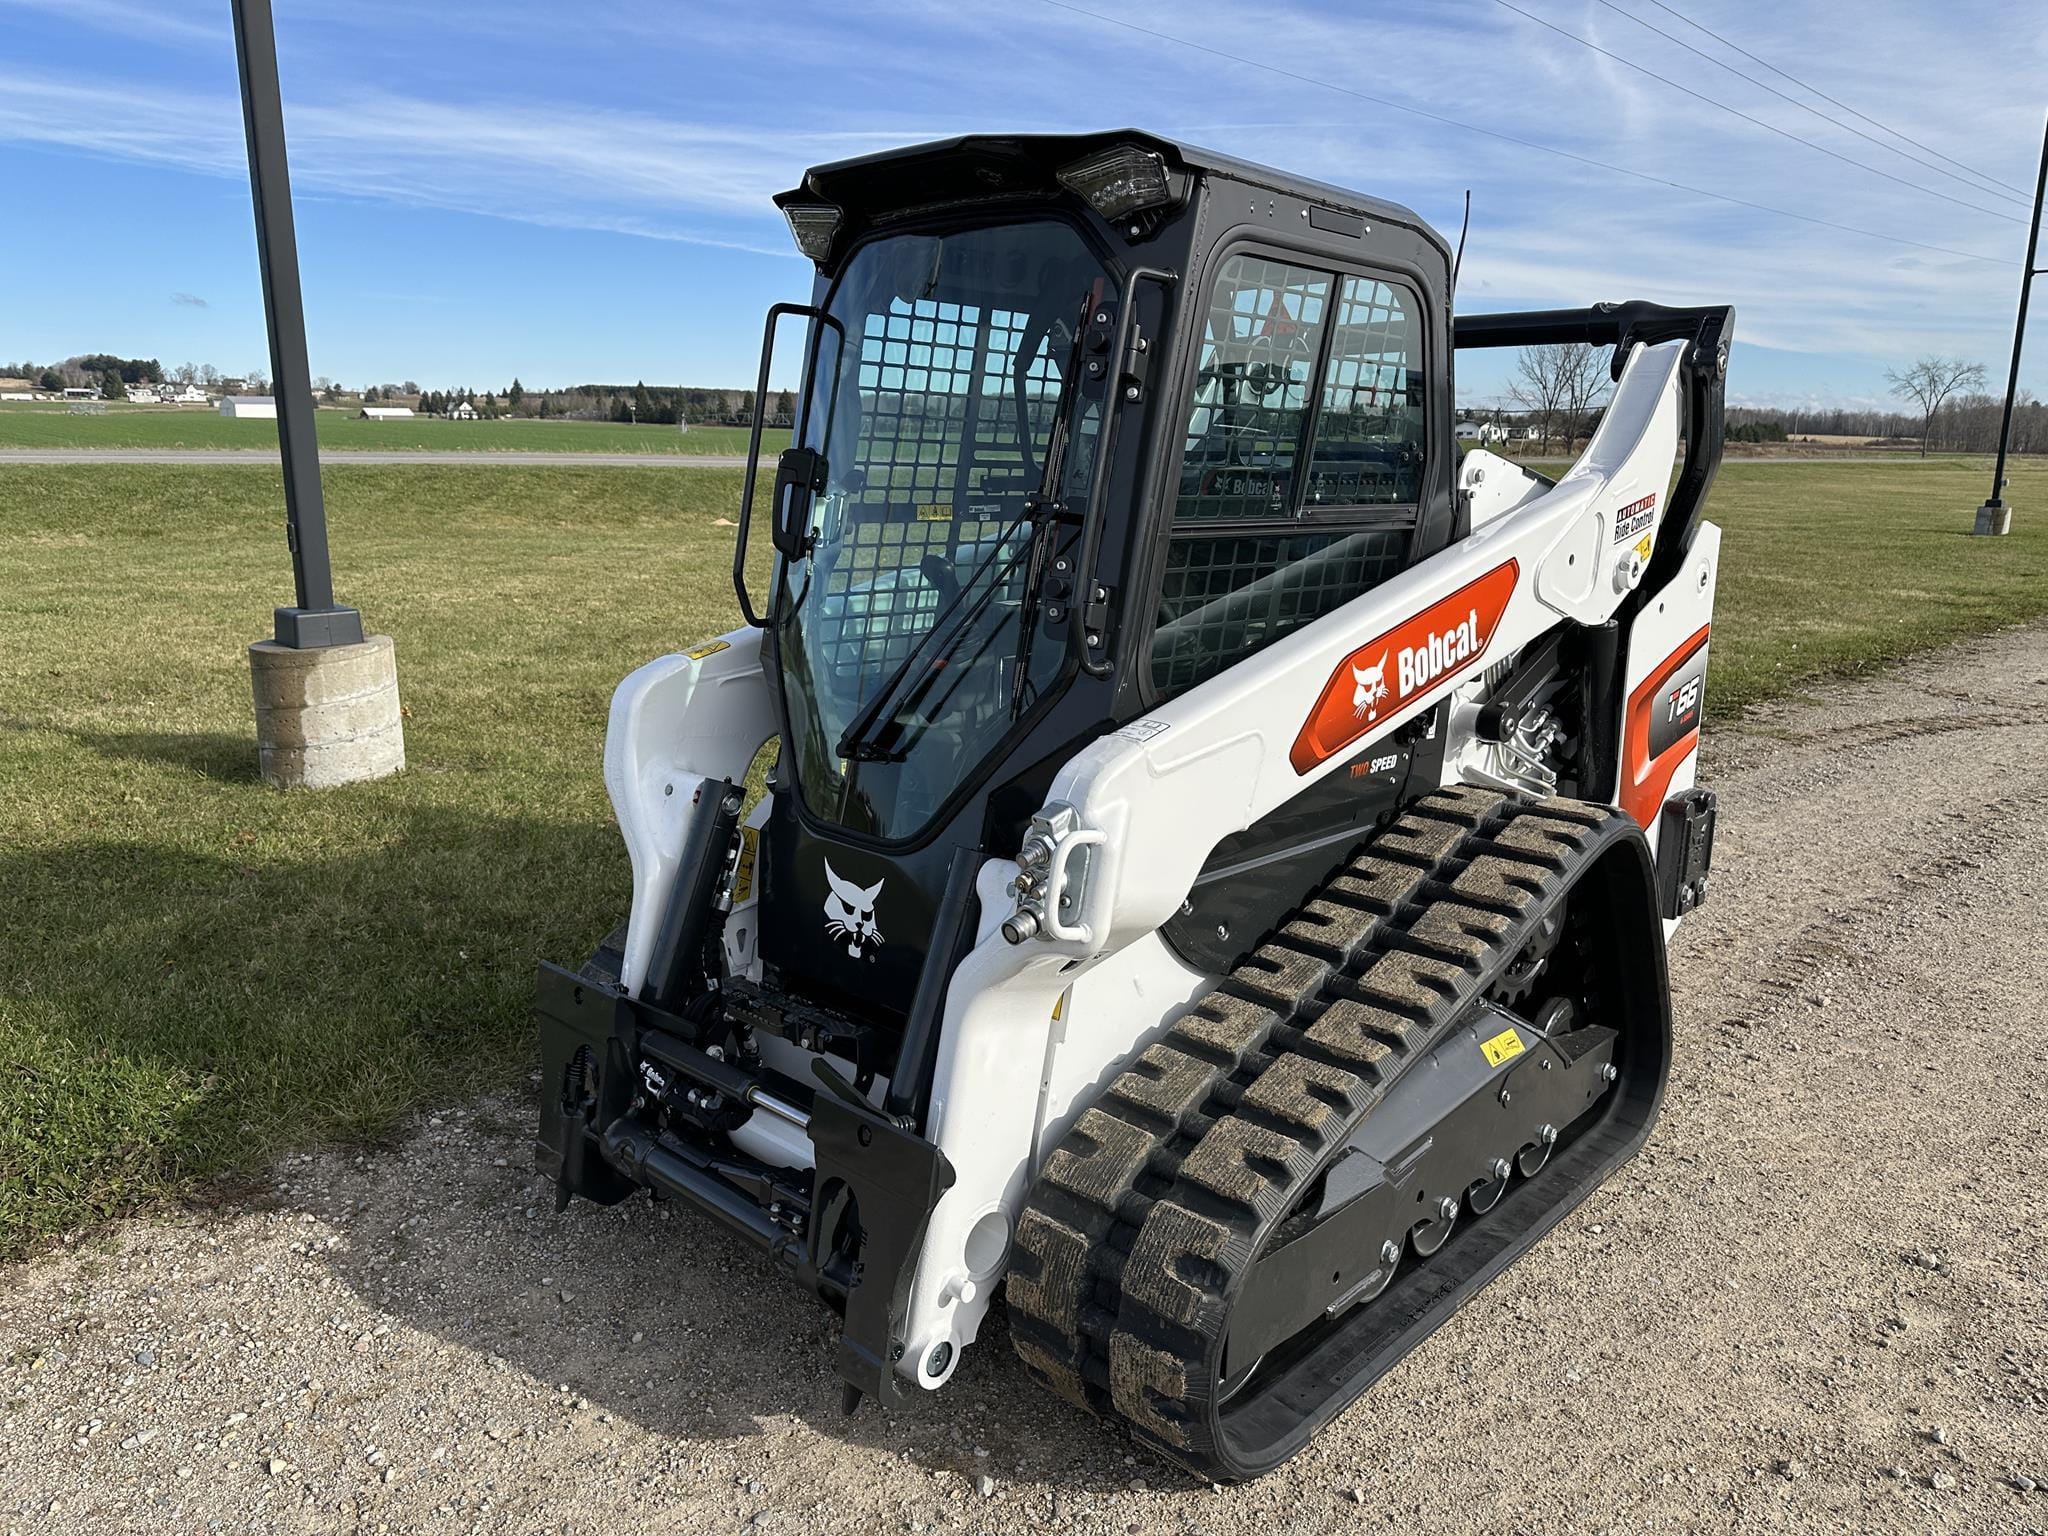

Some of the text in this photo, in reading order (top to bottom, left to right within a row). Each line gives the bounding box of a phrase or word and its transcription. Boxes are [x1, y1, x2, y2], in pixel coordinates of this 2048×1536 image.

[1614, 508, 1655, 541] Ride Control
[1617, 493, 1656, 523] AUTOMATIC
[1397, 608, 1479, 698] Bobcat
[1668, 675, 1700, 723] T66
[1350, 754, 1398, 779] TWO SPEED
